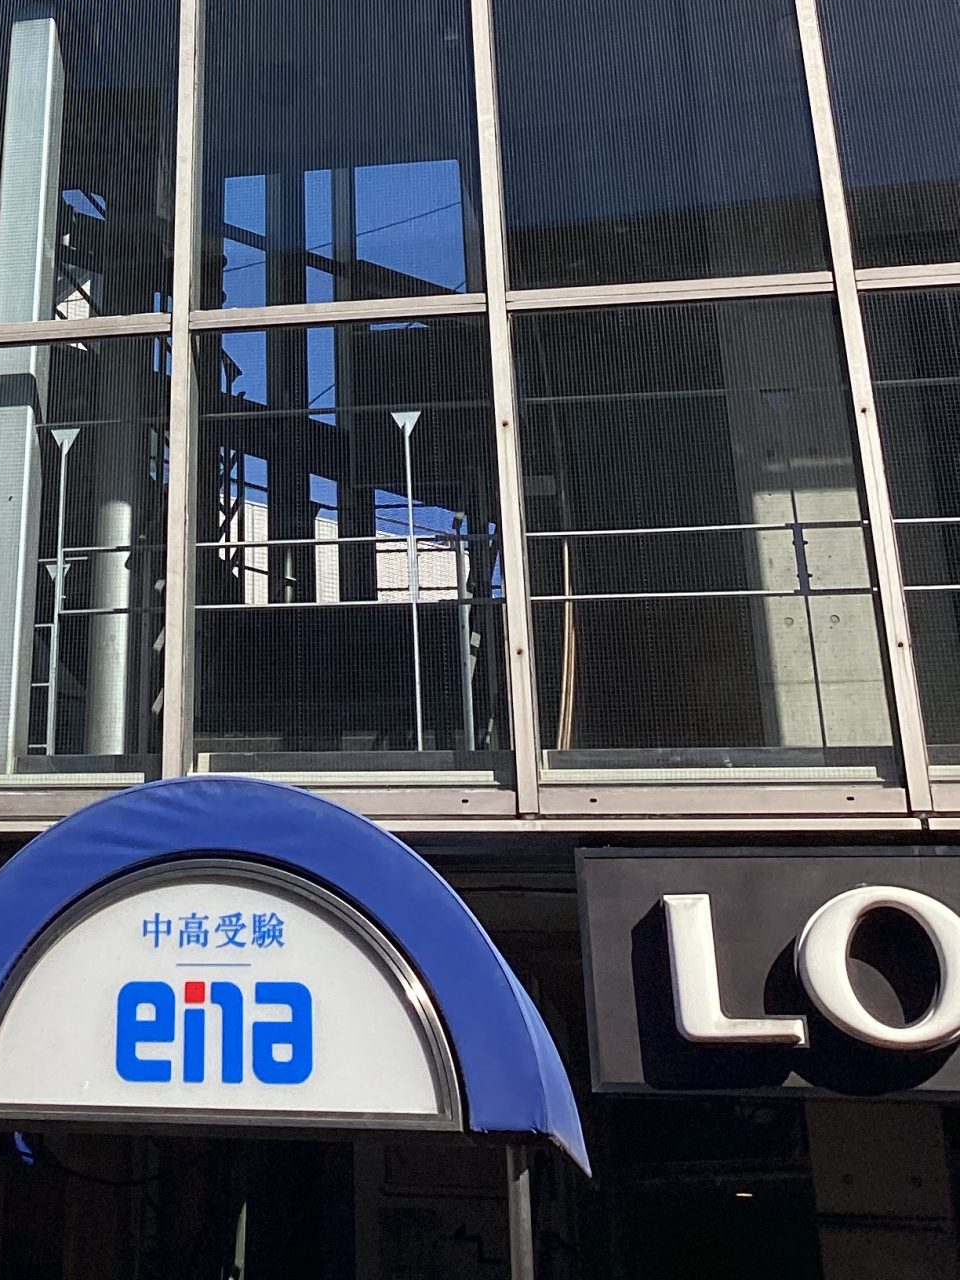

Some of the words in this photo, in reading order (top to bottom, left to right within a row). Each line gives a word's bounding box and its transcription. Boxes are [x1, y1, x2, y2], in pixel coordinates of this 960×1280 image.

[142, 911, 286, 949] 中高受験
[115, 980, 314, 1085] ena
